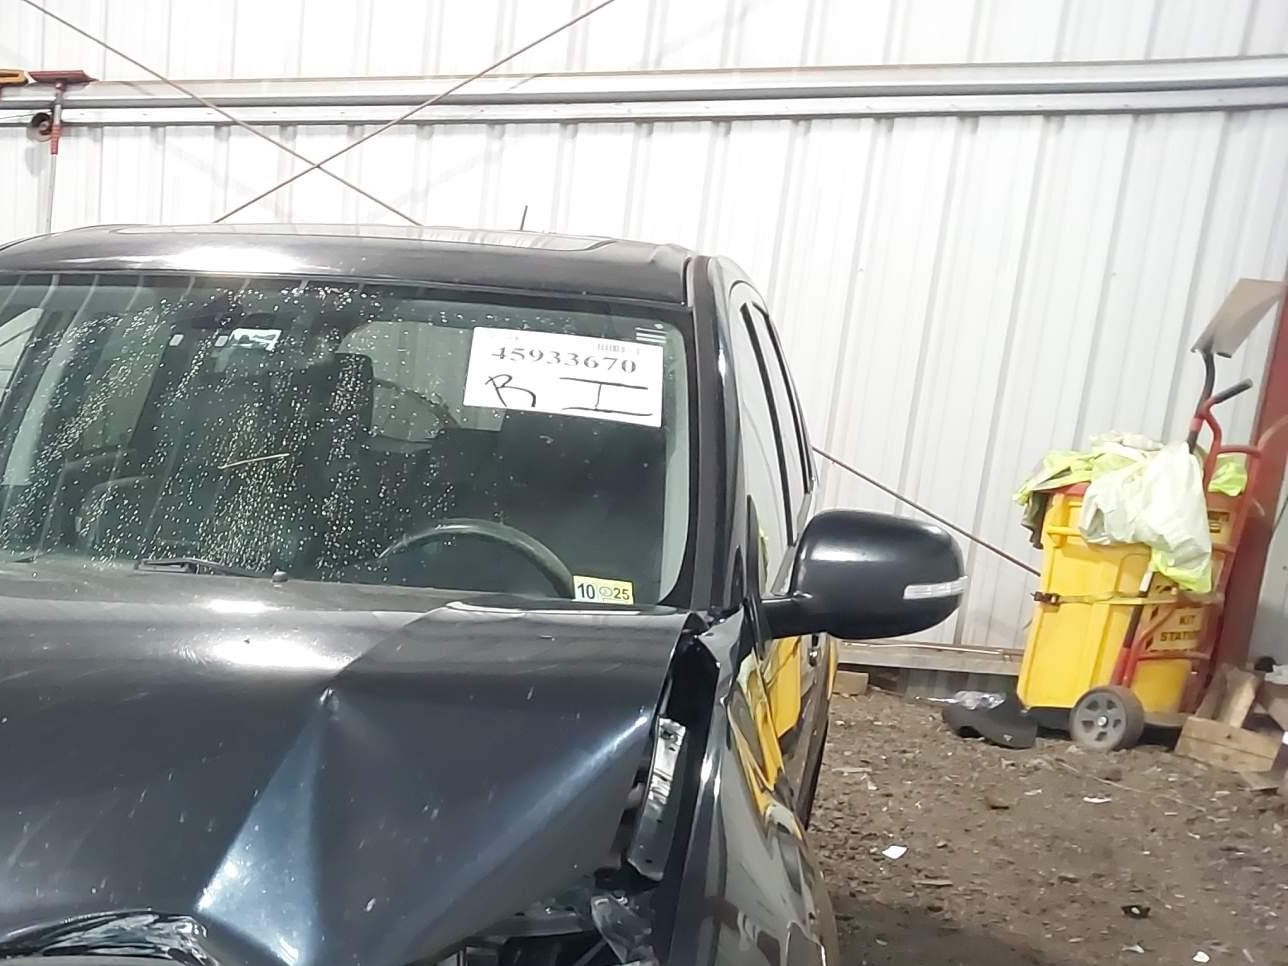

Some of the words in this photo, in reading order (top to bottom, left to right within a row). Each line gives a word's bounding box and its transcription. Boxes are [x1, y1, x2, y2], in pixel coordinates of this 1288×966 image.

[491, 346, 637, 374] 45933670
[577, 582, 596, 600] 10
[613, 587, 630, 601] 25
